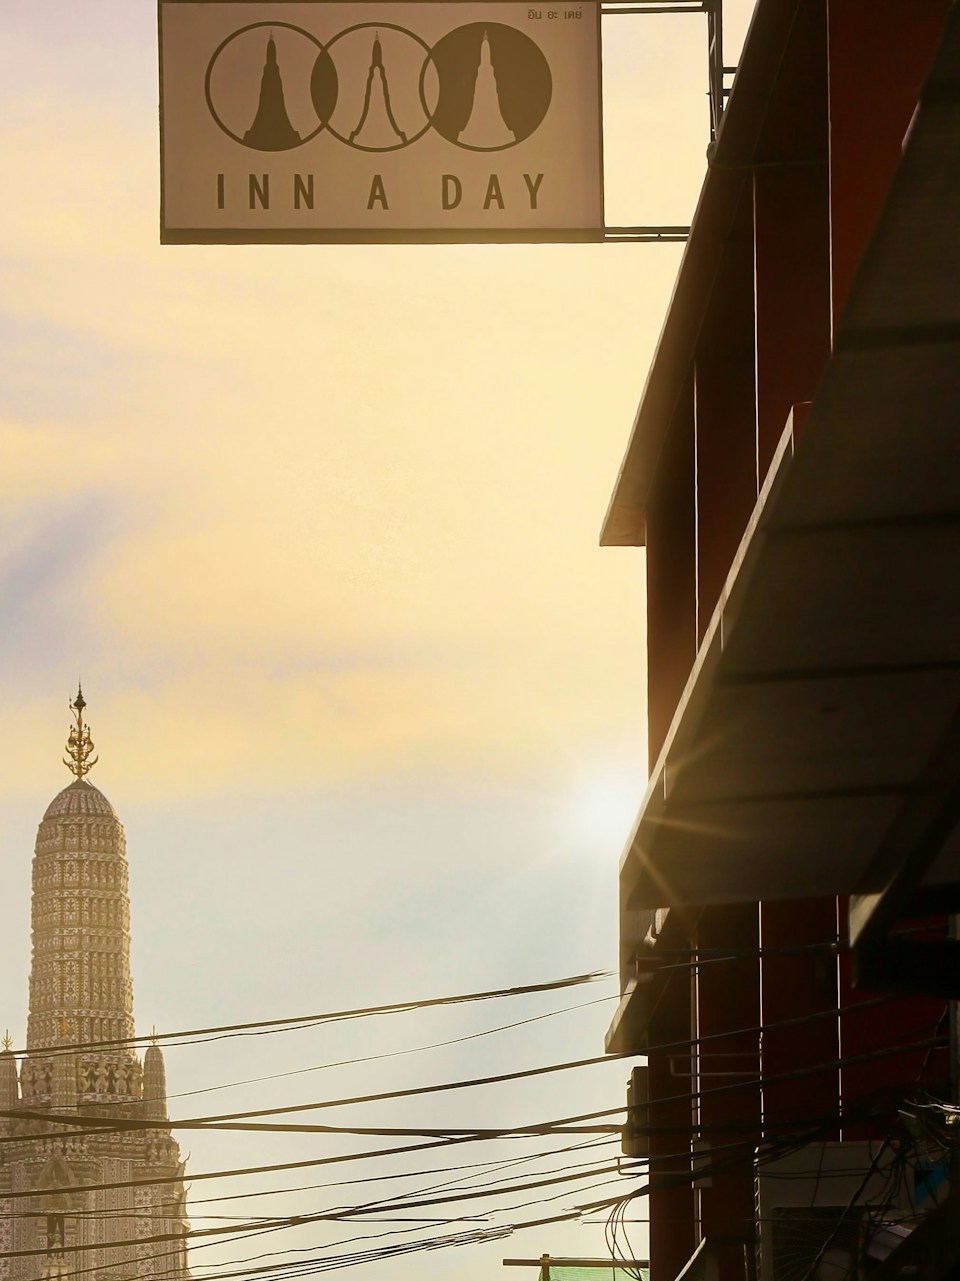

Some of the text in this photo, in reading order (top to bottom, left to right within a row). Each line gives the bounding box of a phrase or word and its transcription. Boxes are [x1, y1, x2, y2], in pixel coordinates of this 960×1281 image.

[217, 173, 545, 210] INN A DAY
